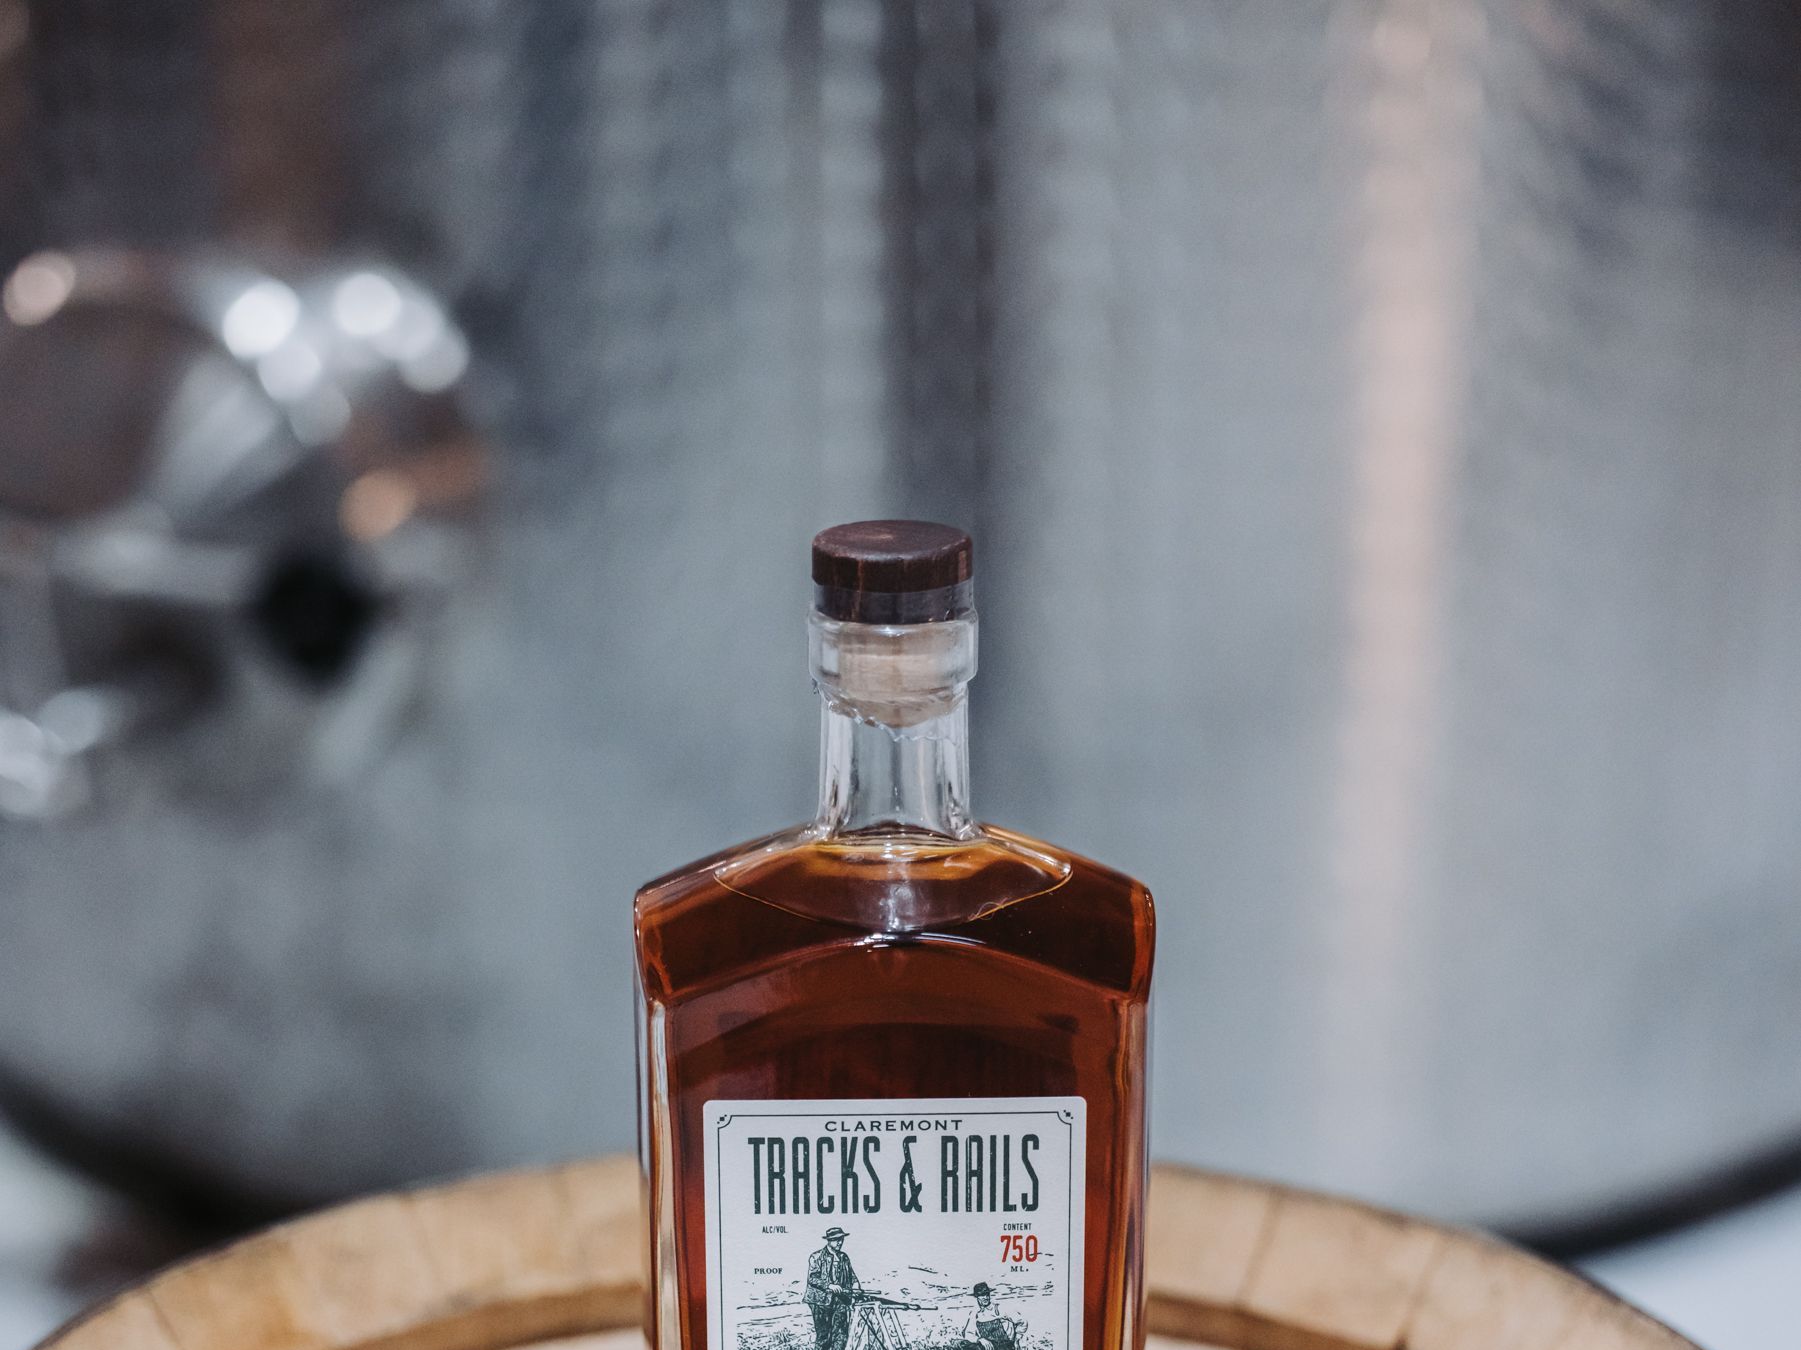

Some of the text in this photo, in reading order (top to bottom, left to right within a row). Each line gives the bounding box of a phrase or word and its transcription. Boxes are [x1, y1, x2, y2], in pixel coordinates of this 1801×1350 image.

[824, 1119, 963, 1132] CLAREMONT
[747, 1134, 1040, 1215] TRACKS & RAILS
[1002, 1222, 1032, 1232] CONTENT
[1000, 1234, 1038, 1263] 750
[753, 1266, 783, 1275] PROOF
